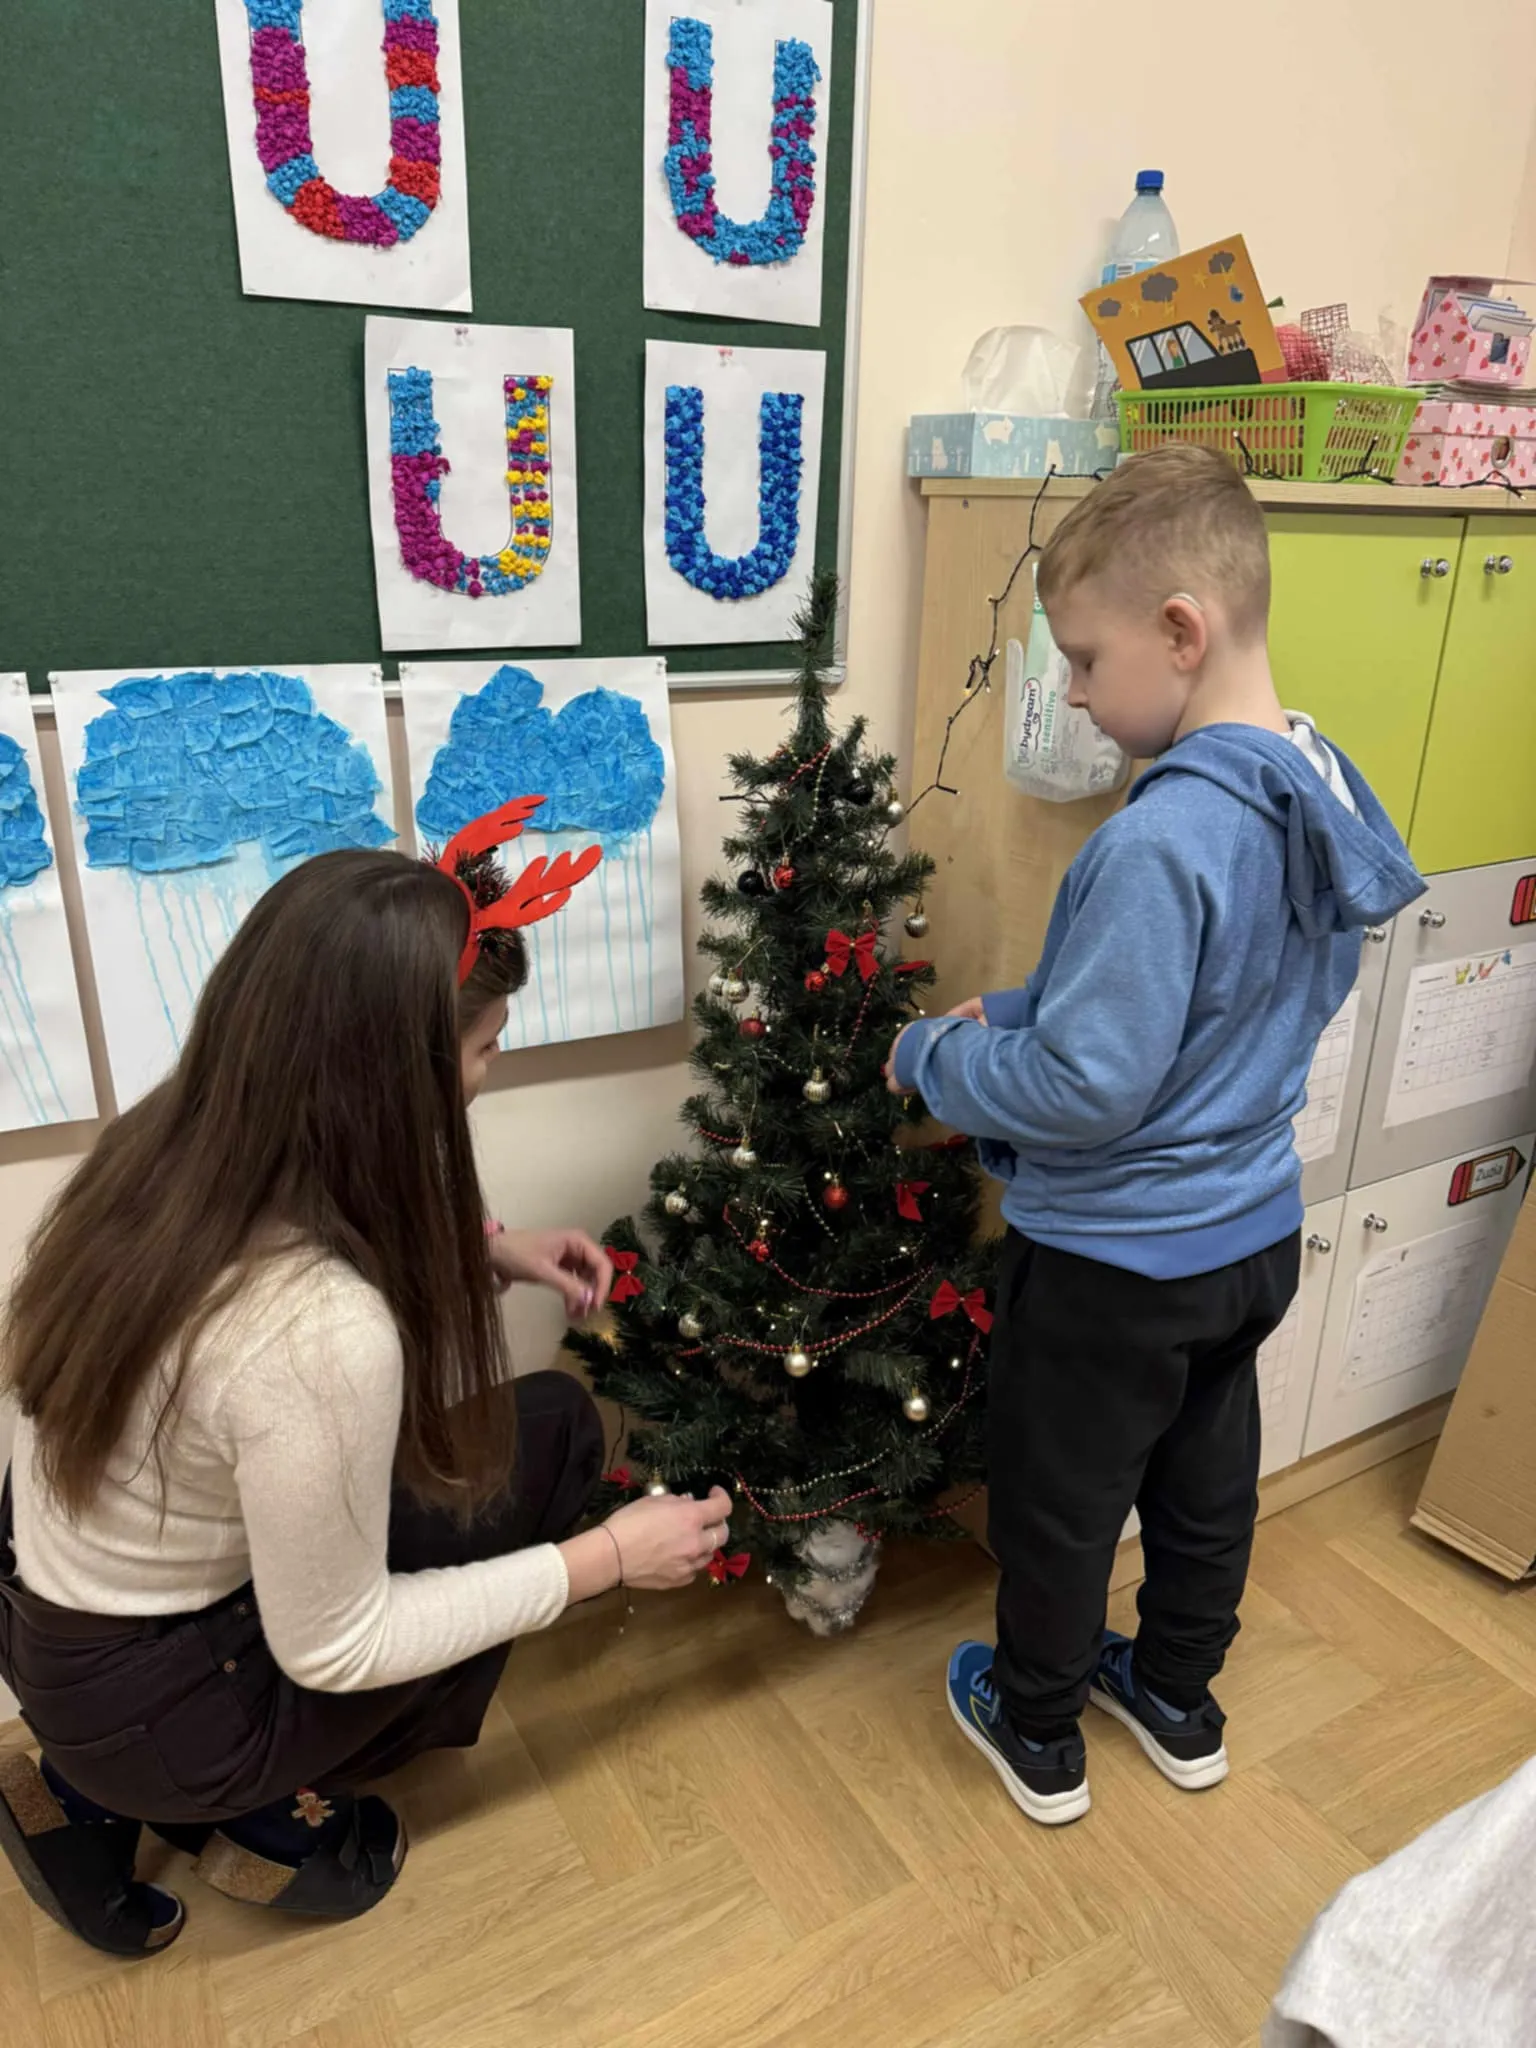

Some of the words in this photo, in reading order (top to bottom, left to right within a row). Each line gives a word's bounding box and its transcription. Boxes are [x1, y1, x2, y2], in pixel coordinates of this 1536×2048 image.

[249, 0, 441, 248] U
[665, 16, 822, 266] U
[387, 366, 556, 598] U
[665, 384, 806, 600] U
[1043, 690, 1057, 744] sensitive
